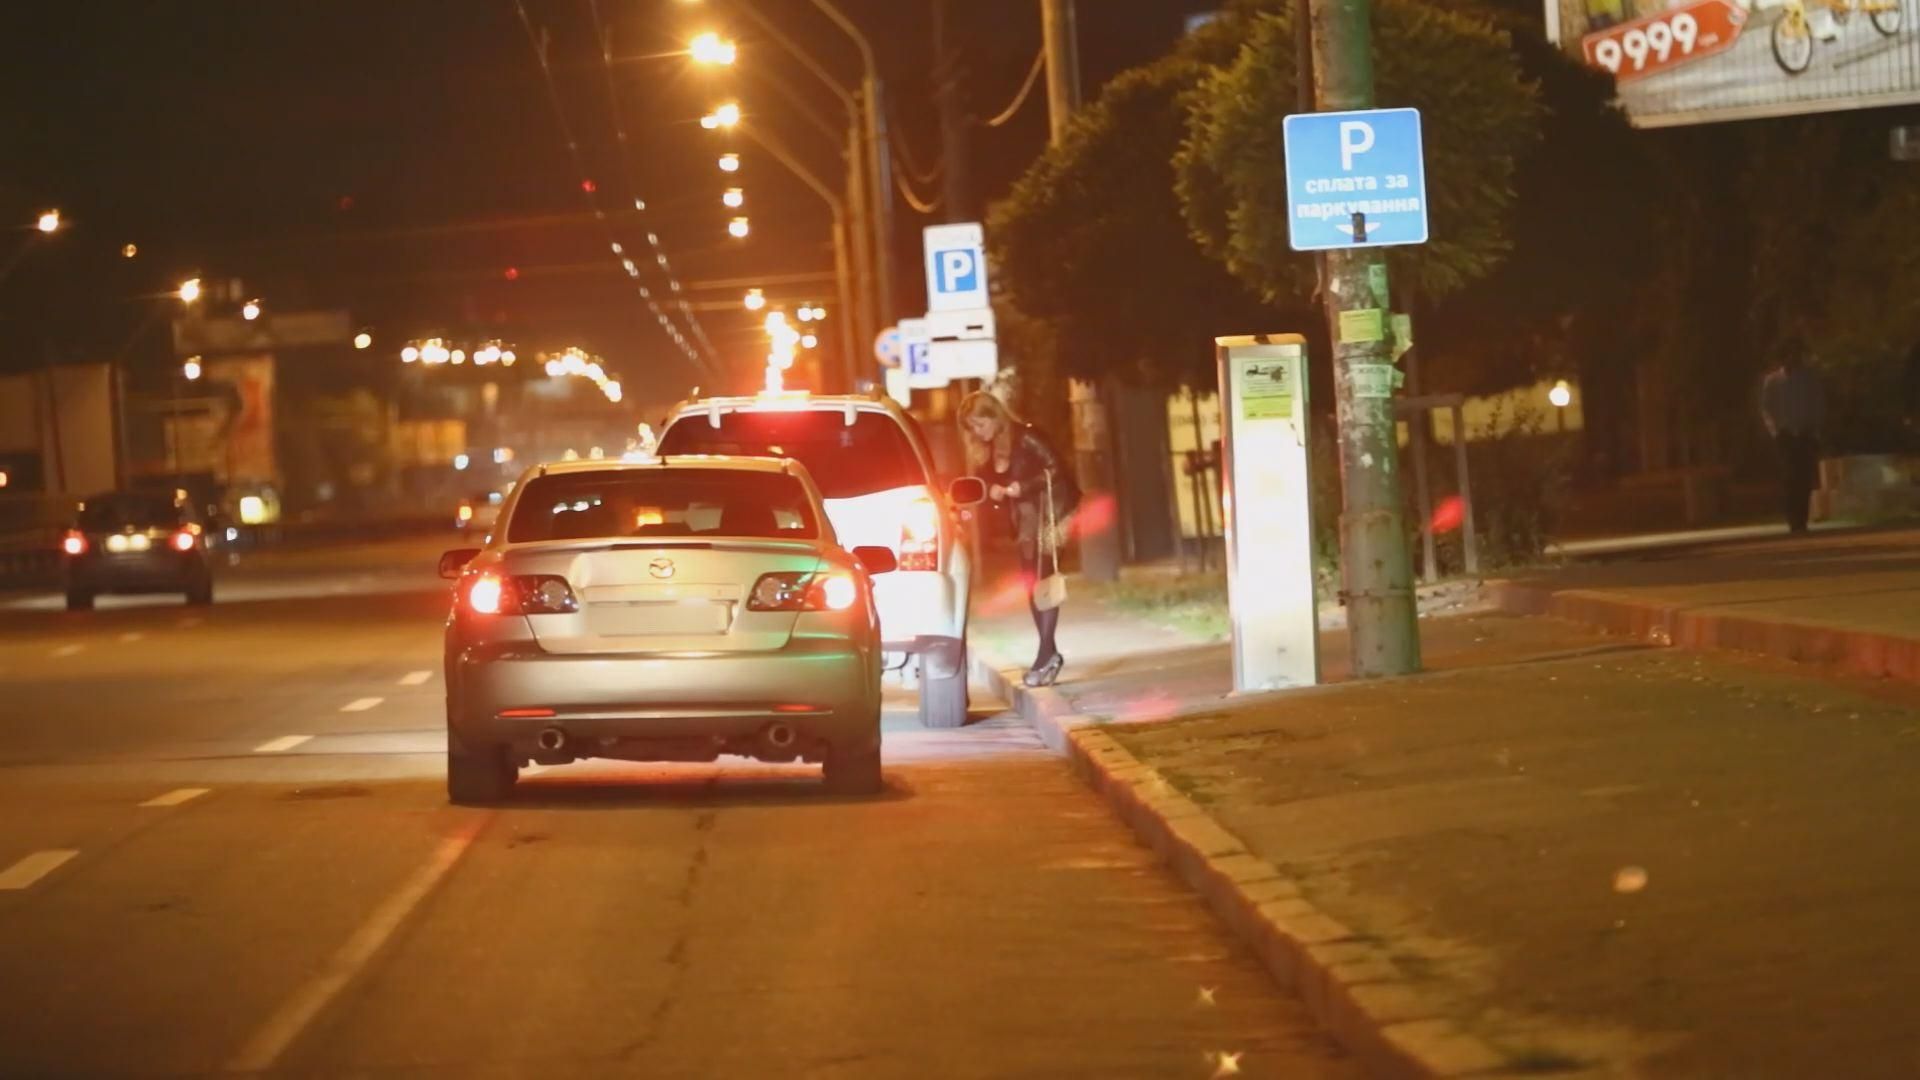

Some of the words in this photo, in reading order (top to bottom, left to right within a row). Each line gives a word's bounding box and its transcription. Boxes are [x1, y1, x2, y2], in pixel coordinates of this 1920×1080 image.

[1596, 13, 1698, 72] 9999
[1340, 121, 1375, 170] P
[1305, 176, 1377, 194] сплата
[1385, 174, 1409, 189] за
[1297, 198, 1420, 221] паркування
[942, 251, 973, 292] P
